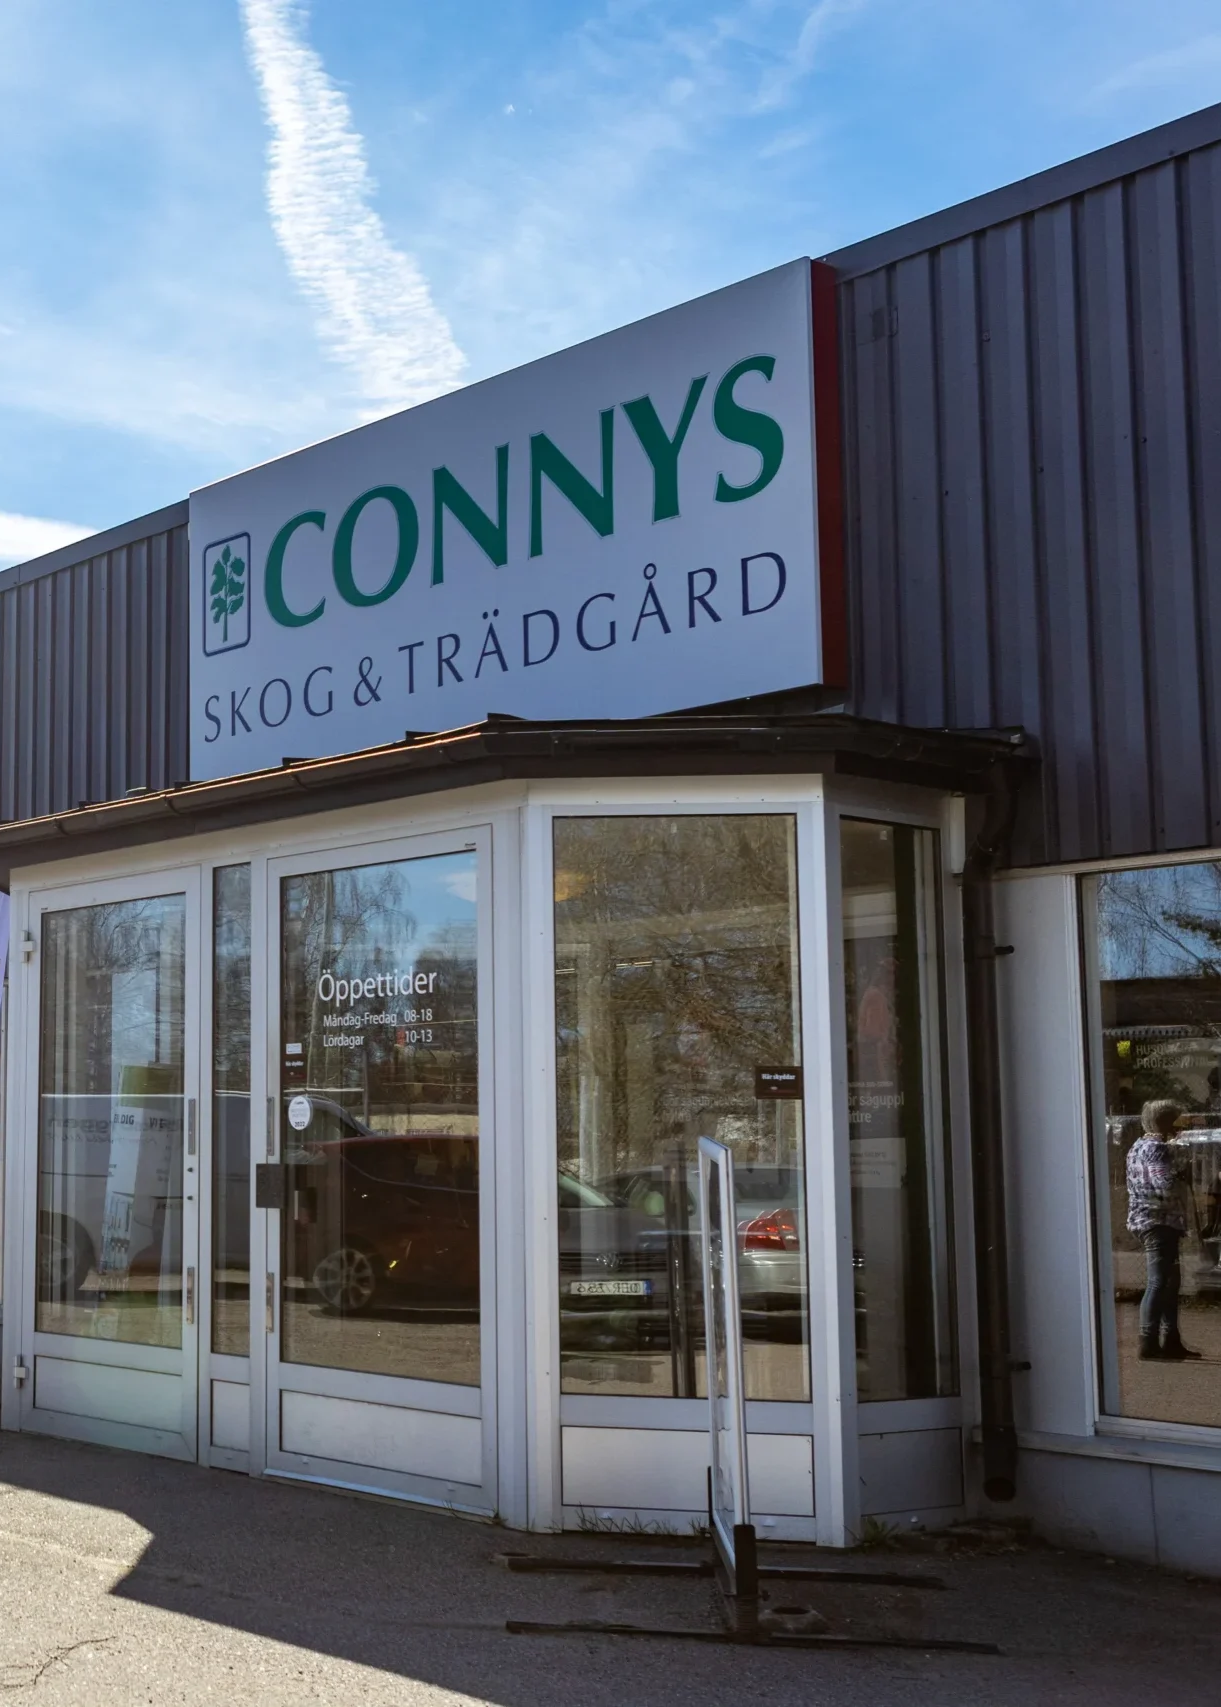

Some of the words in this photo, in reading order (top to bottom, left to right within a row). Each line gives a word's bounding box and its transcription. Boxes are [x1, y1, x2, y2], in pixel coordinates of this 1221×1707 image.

[263, 352, 785, 628] CONNYS
[204, 666, 333, 743] SKOG
[353, 655, 383, 707] &
[398, 551, 788, 695] TRÄDGÅRD
[319, 965, 437, 1007] Öppettider
[323, 1011, 397, 1029] Måndag-Fredag
[404, 1008, 433, 1022] 08-18
[323, 1032, 364, 1049] Lördagar
[405, 1029, 433, 1043] 10-13
[773, 1073, 796, 1081] skyddar
